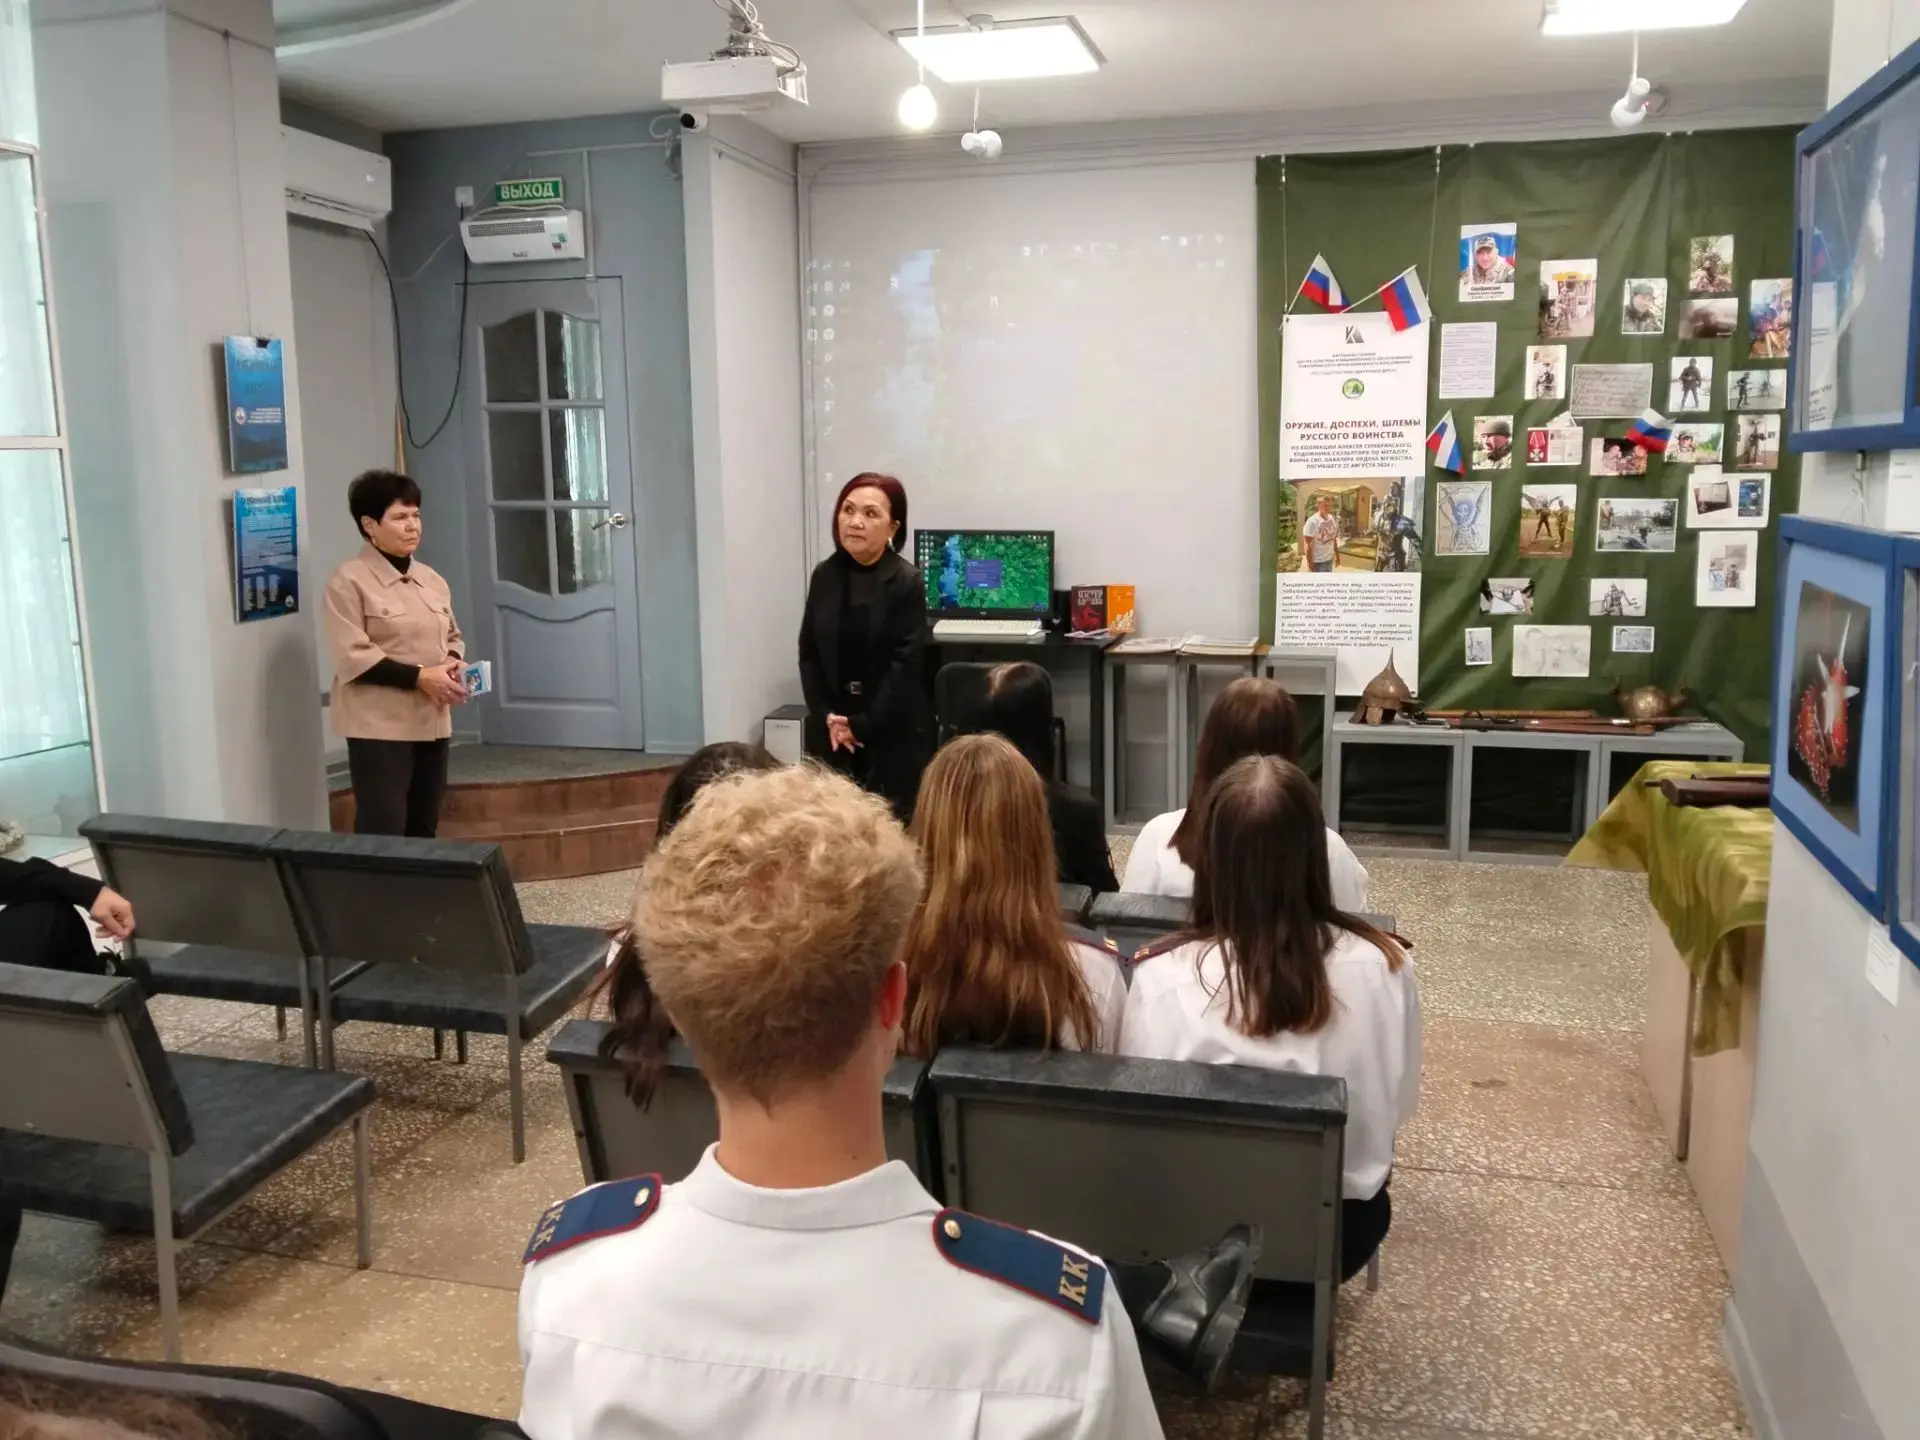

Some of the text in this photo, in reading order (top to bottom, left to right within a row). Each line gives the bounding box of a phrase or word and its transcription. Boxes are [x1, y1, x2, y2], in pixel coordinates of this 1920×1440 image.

[500, 182, 555, 199] ВЫХОД
[1330, 420, 1379, 430] ДОСПЕХИ,
[1382, 419, 1421, 428] ШЛЕМЫ
[1300, 431, 1404, 441] РУССКОГО ВОИНСТВА
[1058, 1253, 1089, 1306] КК
